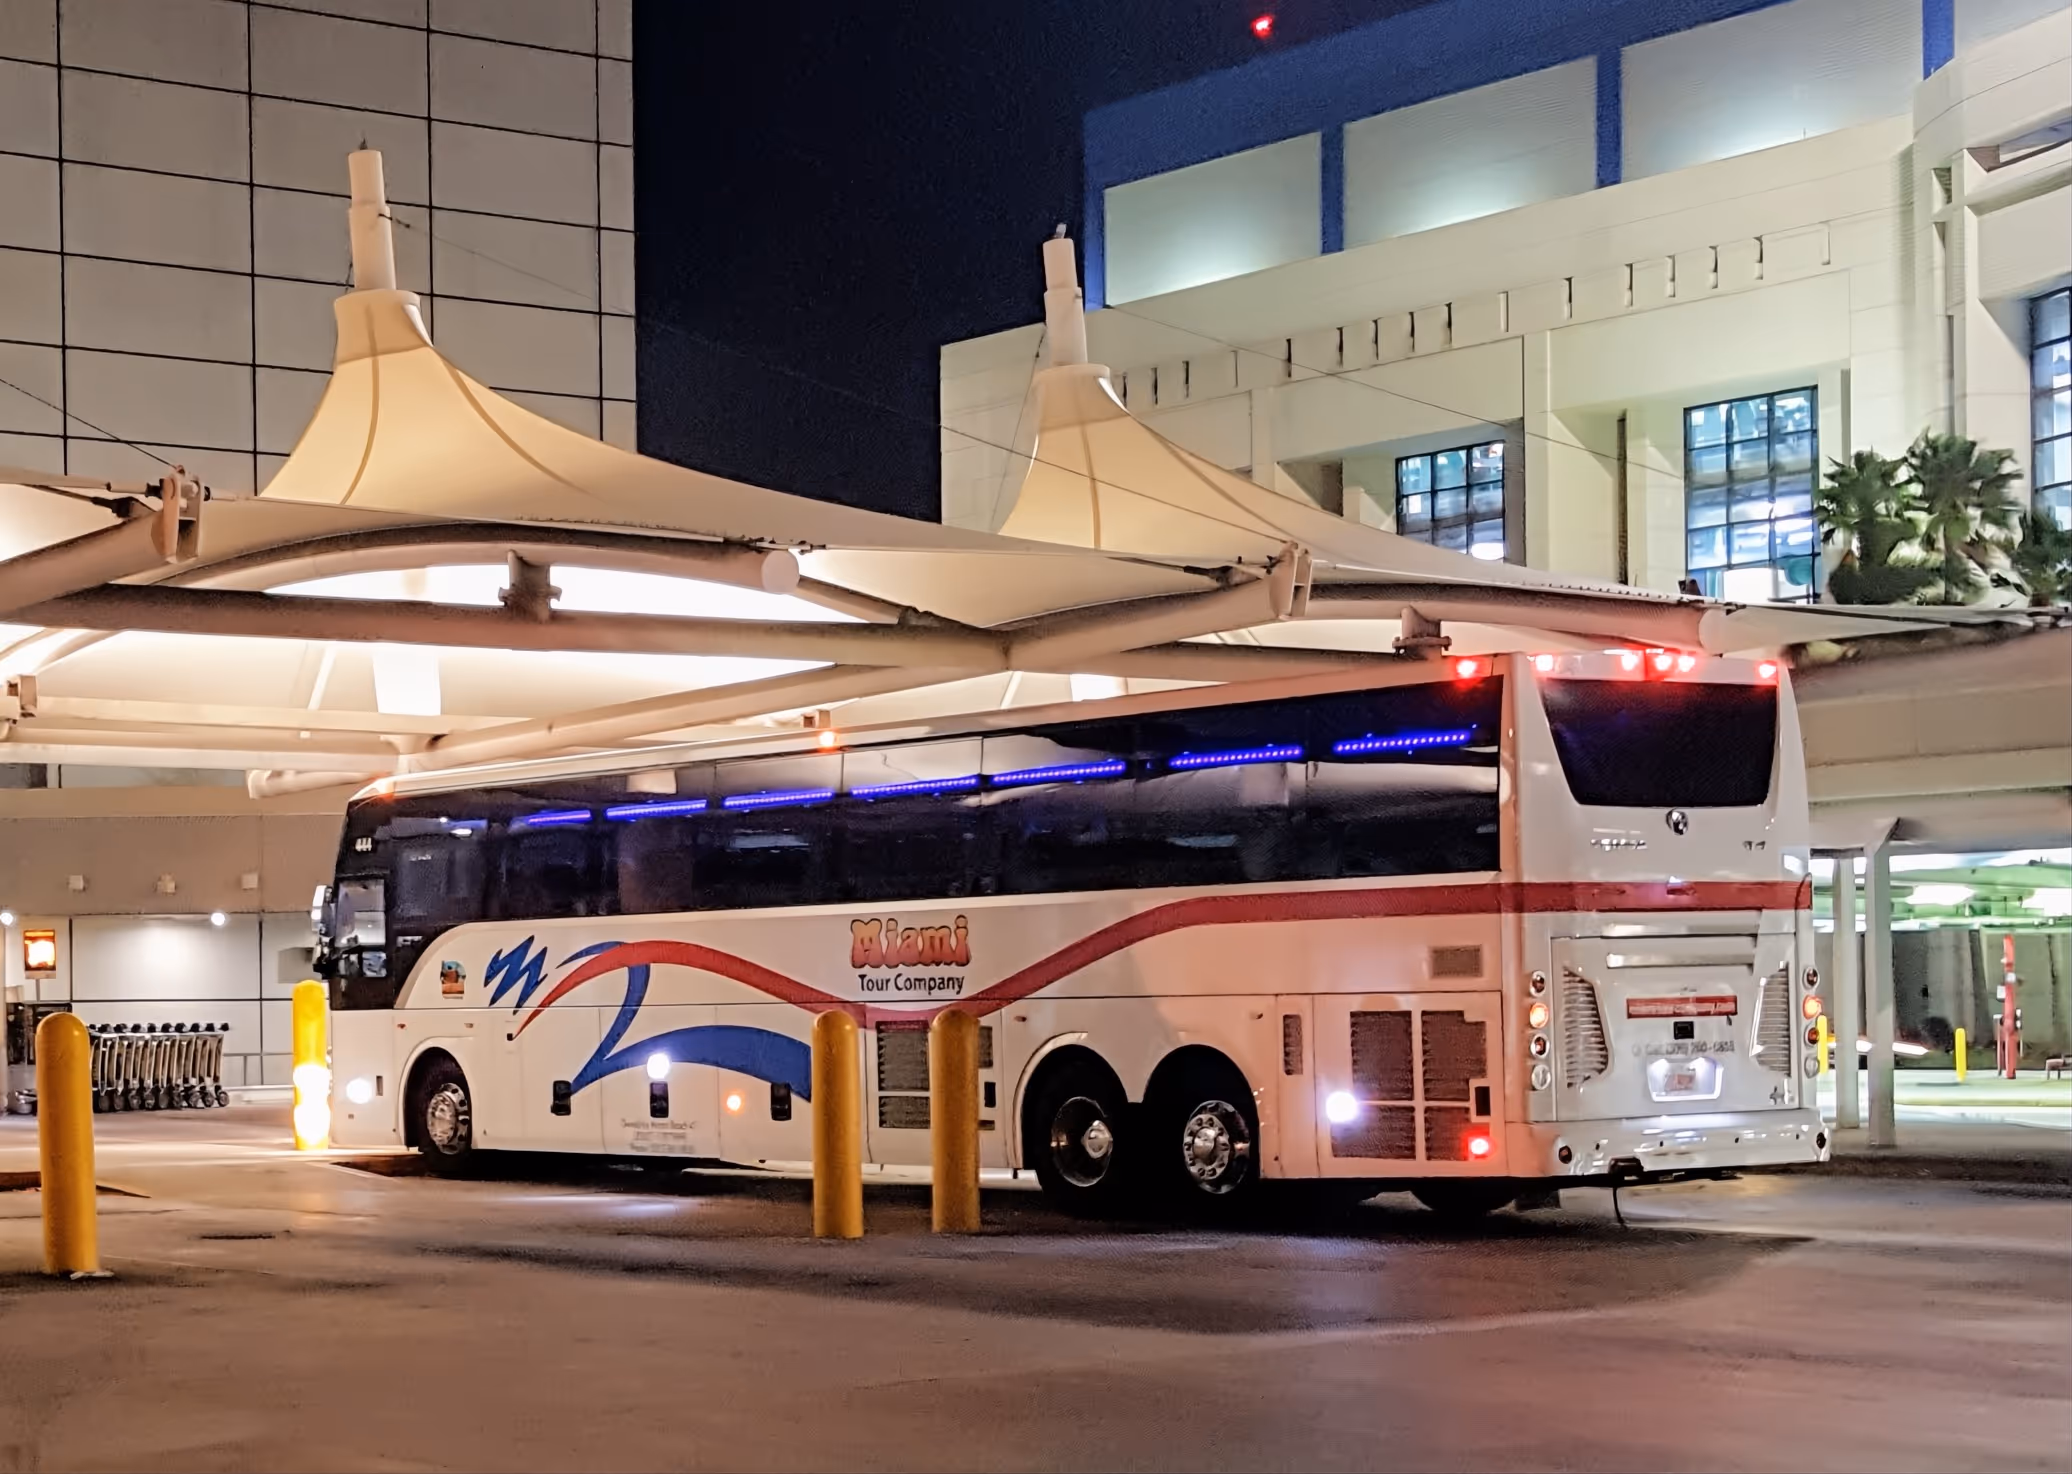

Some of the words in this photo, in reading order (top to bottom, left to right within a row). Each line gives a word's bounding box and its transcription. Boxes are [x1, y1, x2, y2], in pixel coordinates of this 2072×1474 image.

[850, 914, 972, 969] Miami
[858, 974, 891, 992] Tour
[894, 973, 965, 995] Company
